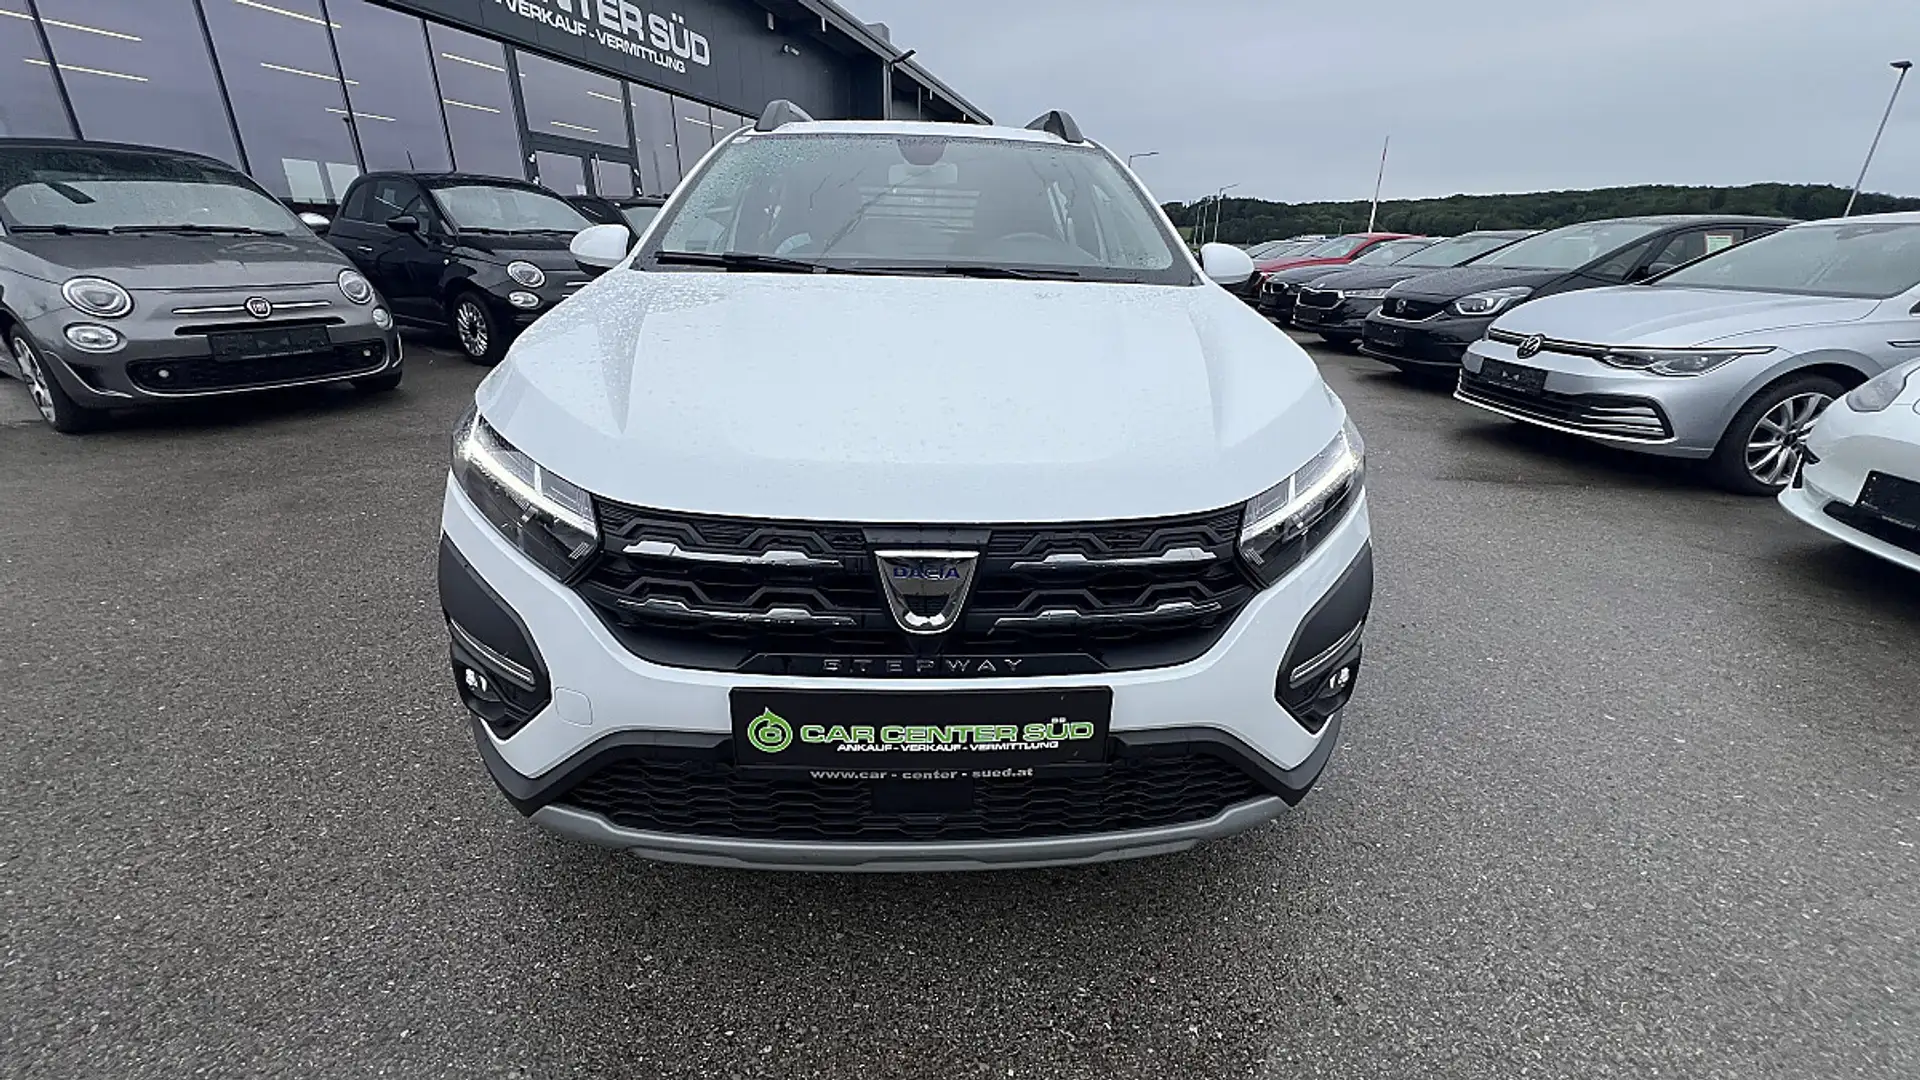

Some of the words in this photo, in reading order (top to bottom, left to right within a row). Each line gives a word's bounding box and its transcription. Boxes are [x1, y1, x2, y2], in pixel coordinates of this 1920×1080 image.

[648, 12, 710, 66] SÜD
[893, 566, 960, 580] DACIA
[823, 659, 1022, 673] STEPWAY
[800, 724, 875, 744] CAR
[880, 724, 1018, 744] CENTER
[1022, 717, 1094, 742] SÜD
